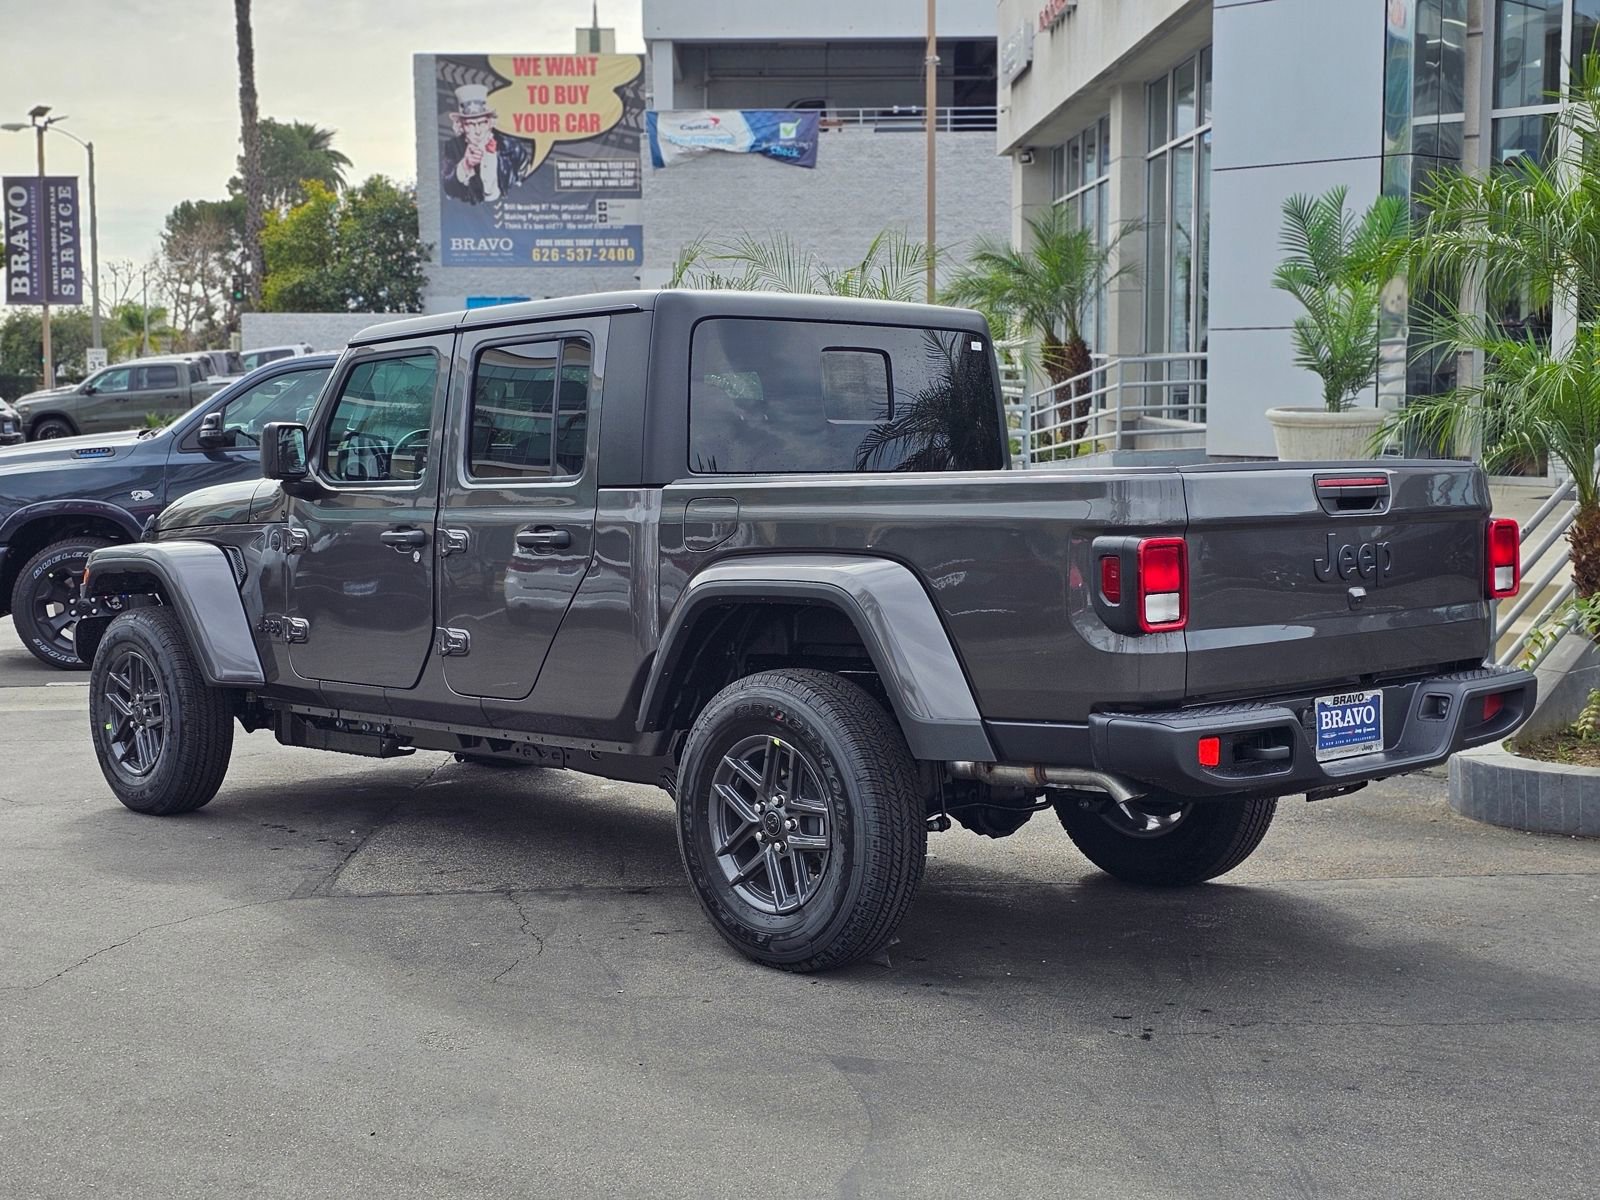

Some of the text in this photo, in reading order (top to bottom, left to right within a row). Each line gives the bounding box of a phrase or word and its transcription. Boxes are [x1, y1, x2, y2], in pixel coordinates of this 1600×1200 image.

[512, 57, 599, 76] WE WANT
[526, 85, 590, 105] TO BUY
[512, 113, 600, 133] YOUR CAR
[8, 186, 30, 296] BRAVO
[58, 186, 75, 296] SERVICE
[450, 238, 514, 251] BRAVO
[532, 247, 635, 262] 626-537-2400
[1313, 533, 1392, 588] Jeep
[1332, 693, 1365, 705] BRAVO
[1320, 706, 1376, 730] BRAVO
